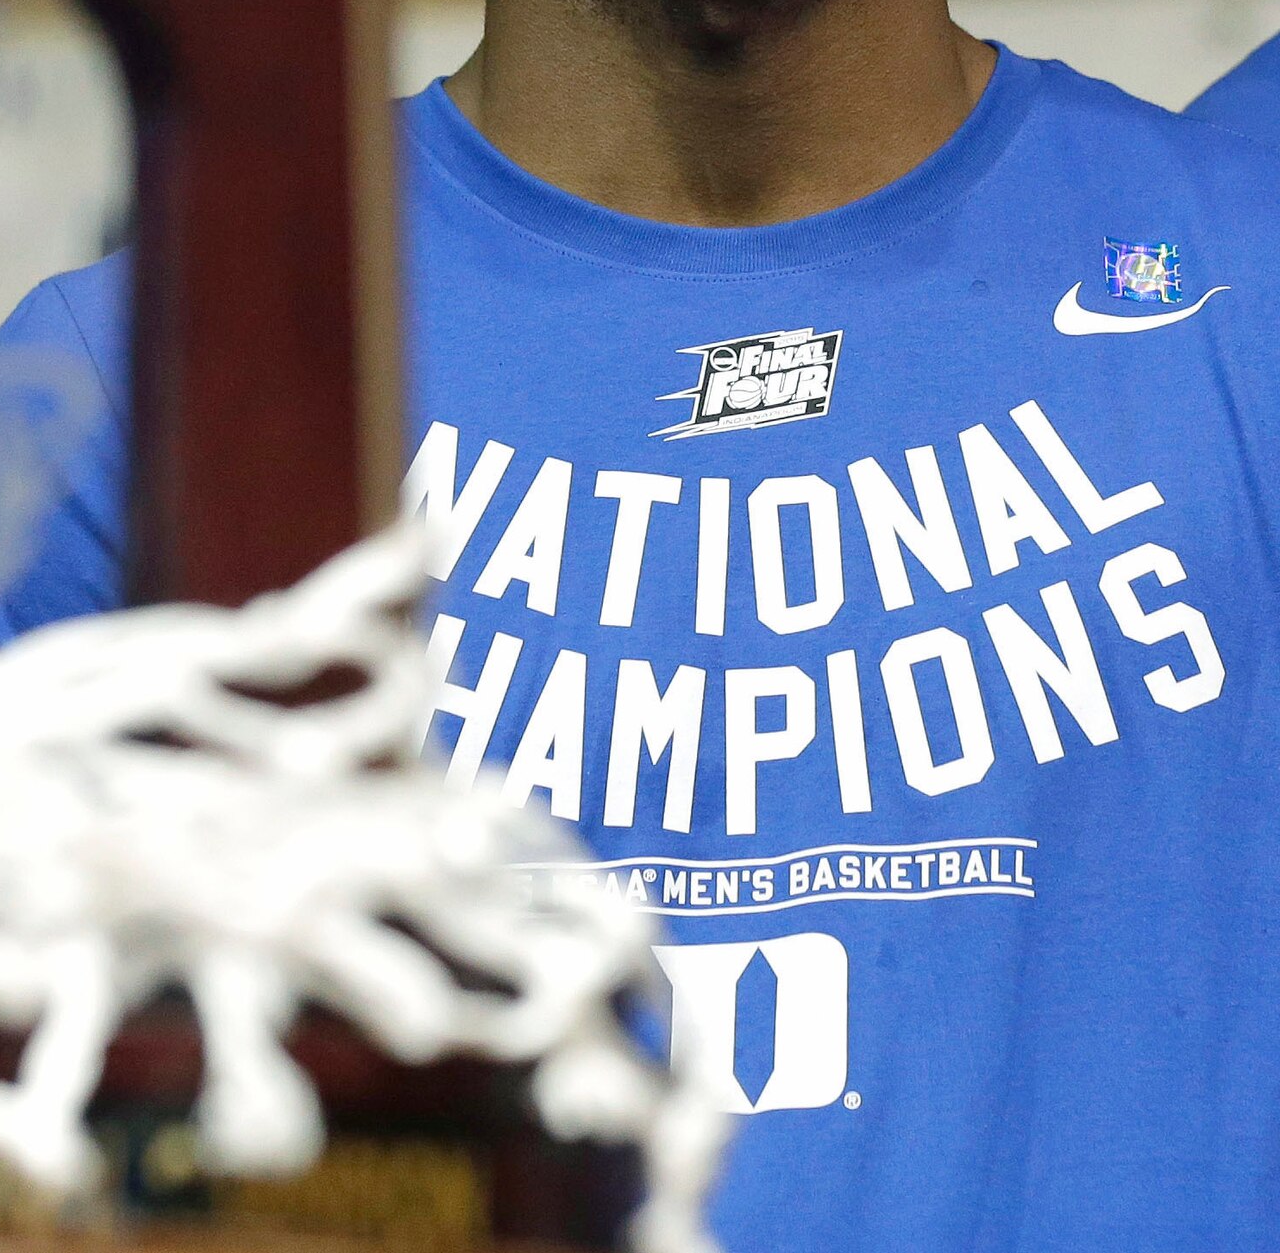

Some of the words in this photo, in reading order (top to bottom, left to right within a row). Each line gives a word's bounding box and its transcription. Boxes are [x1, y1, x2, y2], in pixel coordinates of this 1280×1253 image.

[738, 340, 827, 378] FINAL
[401, 399, 1165, 637] NATIONAL
[420, 543, 1226, 836] HAMPIONS
[662, 868, 775, 906] MEN'S
[788, 848, 1033, 896] BASKETBALL
